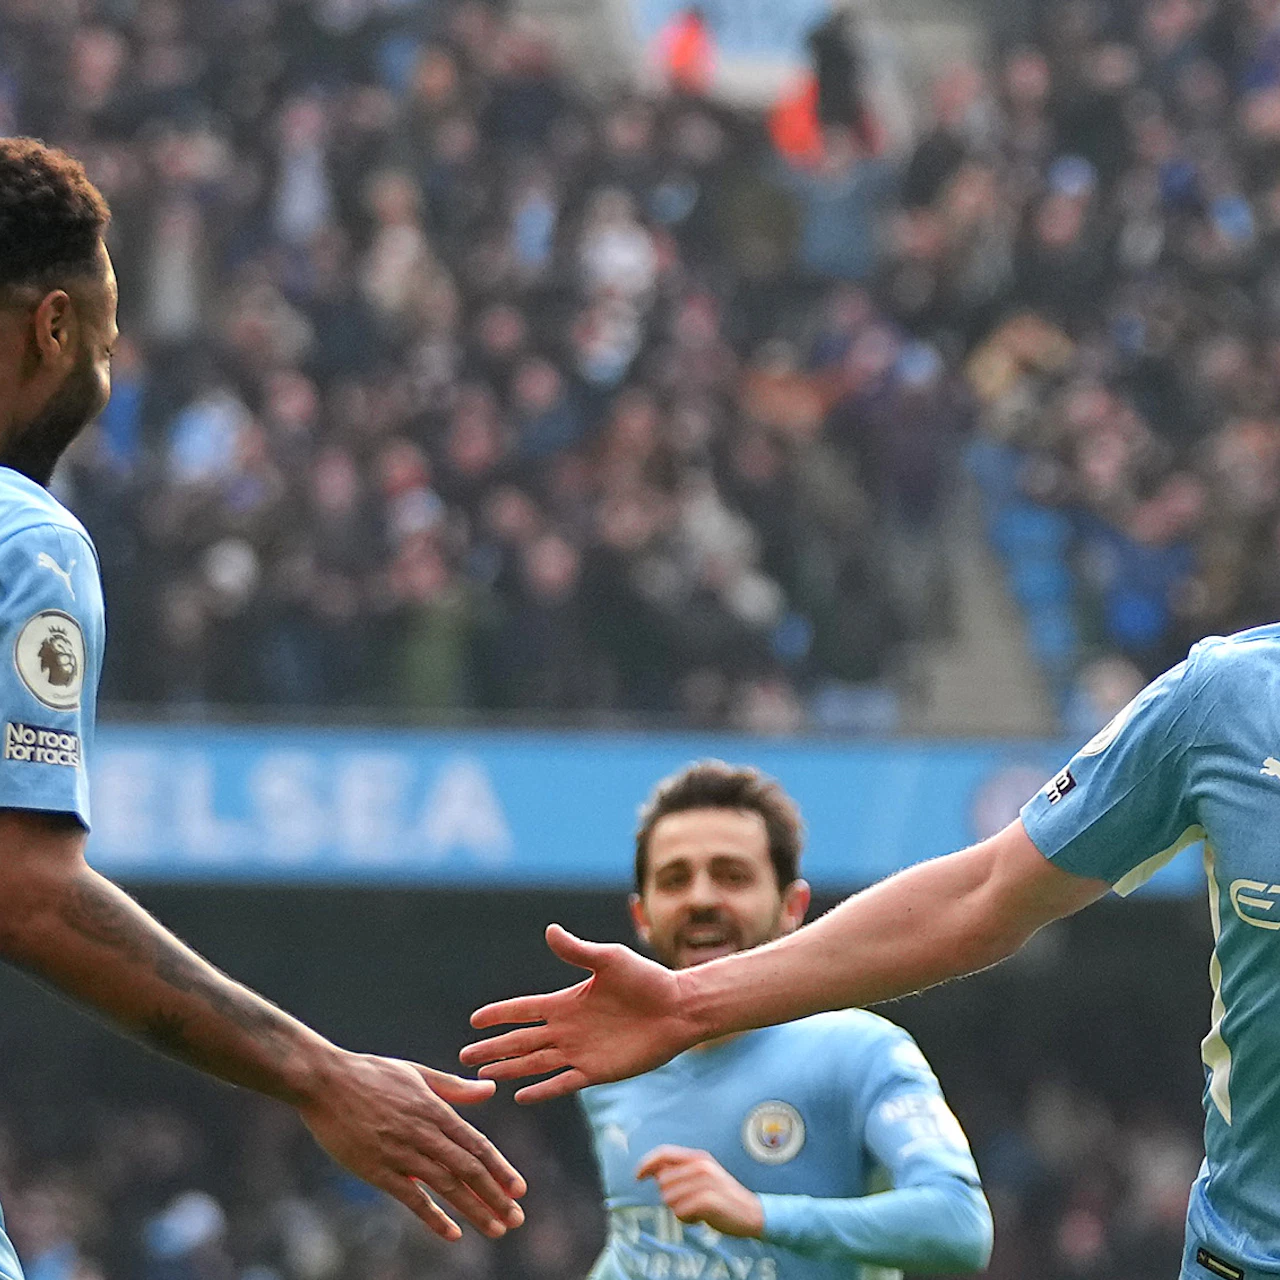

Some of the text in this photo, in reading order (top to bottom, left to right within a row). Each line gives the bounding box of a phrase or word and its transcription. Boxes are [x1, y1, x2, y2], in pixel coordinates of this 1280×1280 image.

[5, 722, 37, 745] No
[4, 740, 35, 761] for
[94, 750, 516, 863] ELSEA
